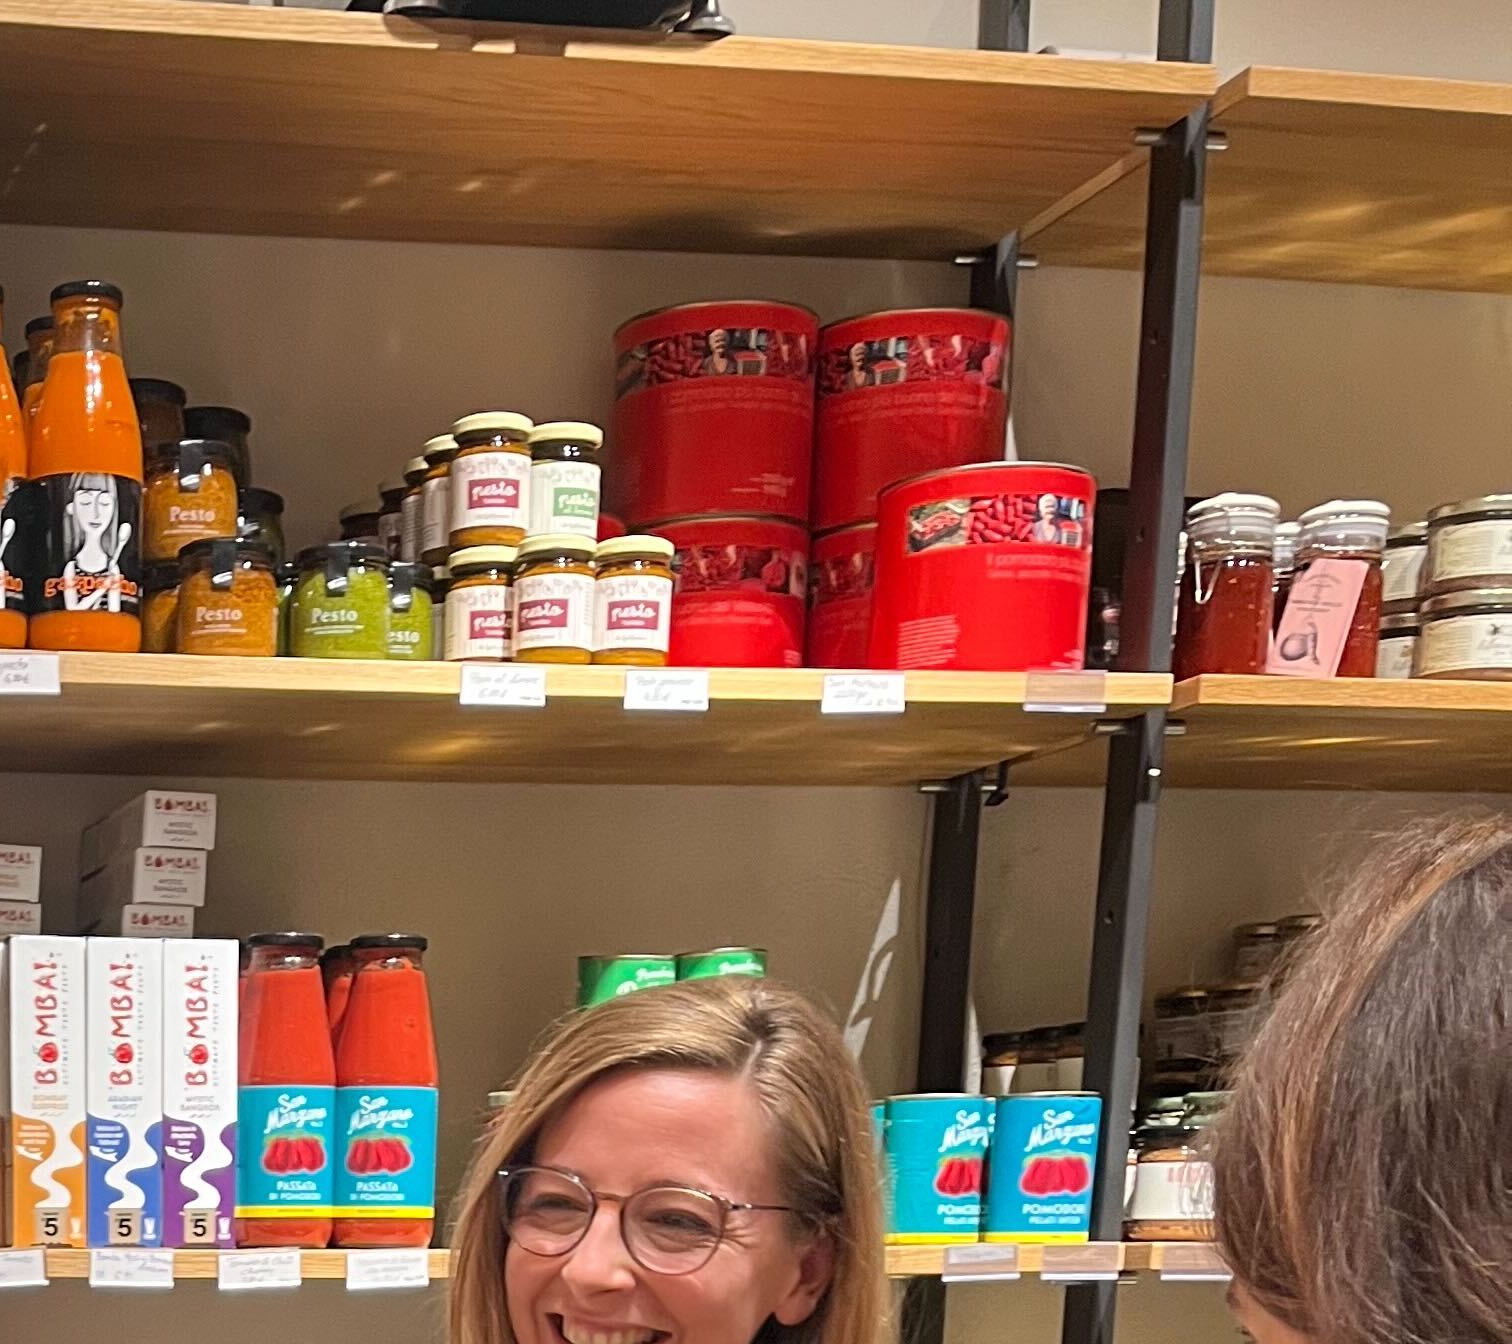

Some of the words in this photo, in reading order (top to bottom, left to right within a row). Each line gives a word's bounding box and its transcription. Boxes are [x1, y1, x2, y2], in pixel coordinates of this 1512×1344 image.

[169, 506, 216, 522] Pesto
[195, 606, 243, 623] Pesto
[311, 608, 358, 622] Pesto
[387, 629, 420, 643] esto
[276, 1181, 317, 1191] PASSATA
[356, 1181, 399, 1192] PASSATA
[44, 1218, 59, 1236] 5
[118, 1219, 132, 1237] 5
[192, 1219, 207, 1237] 5
